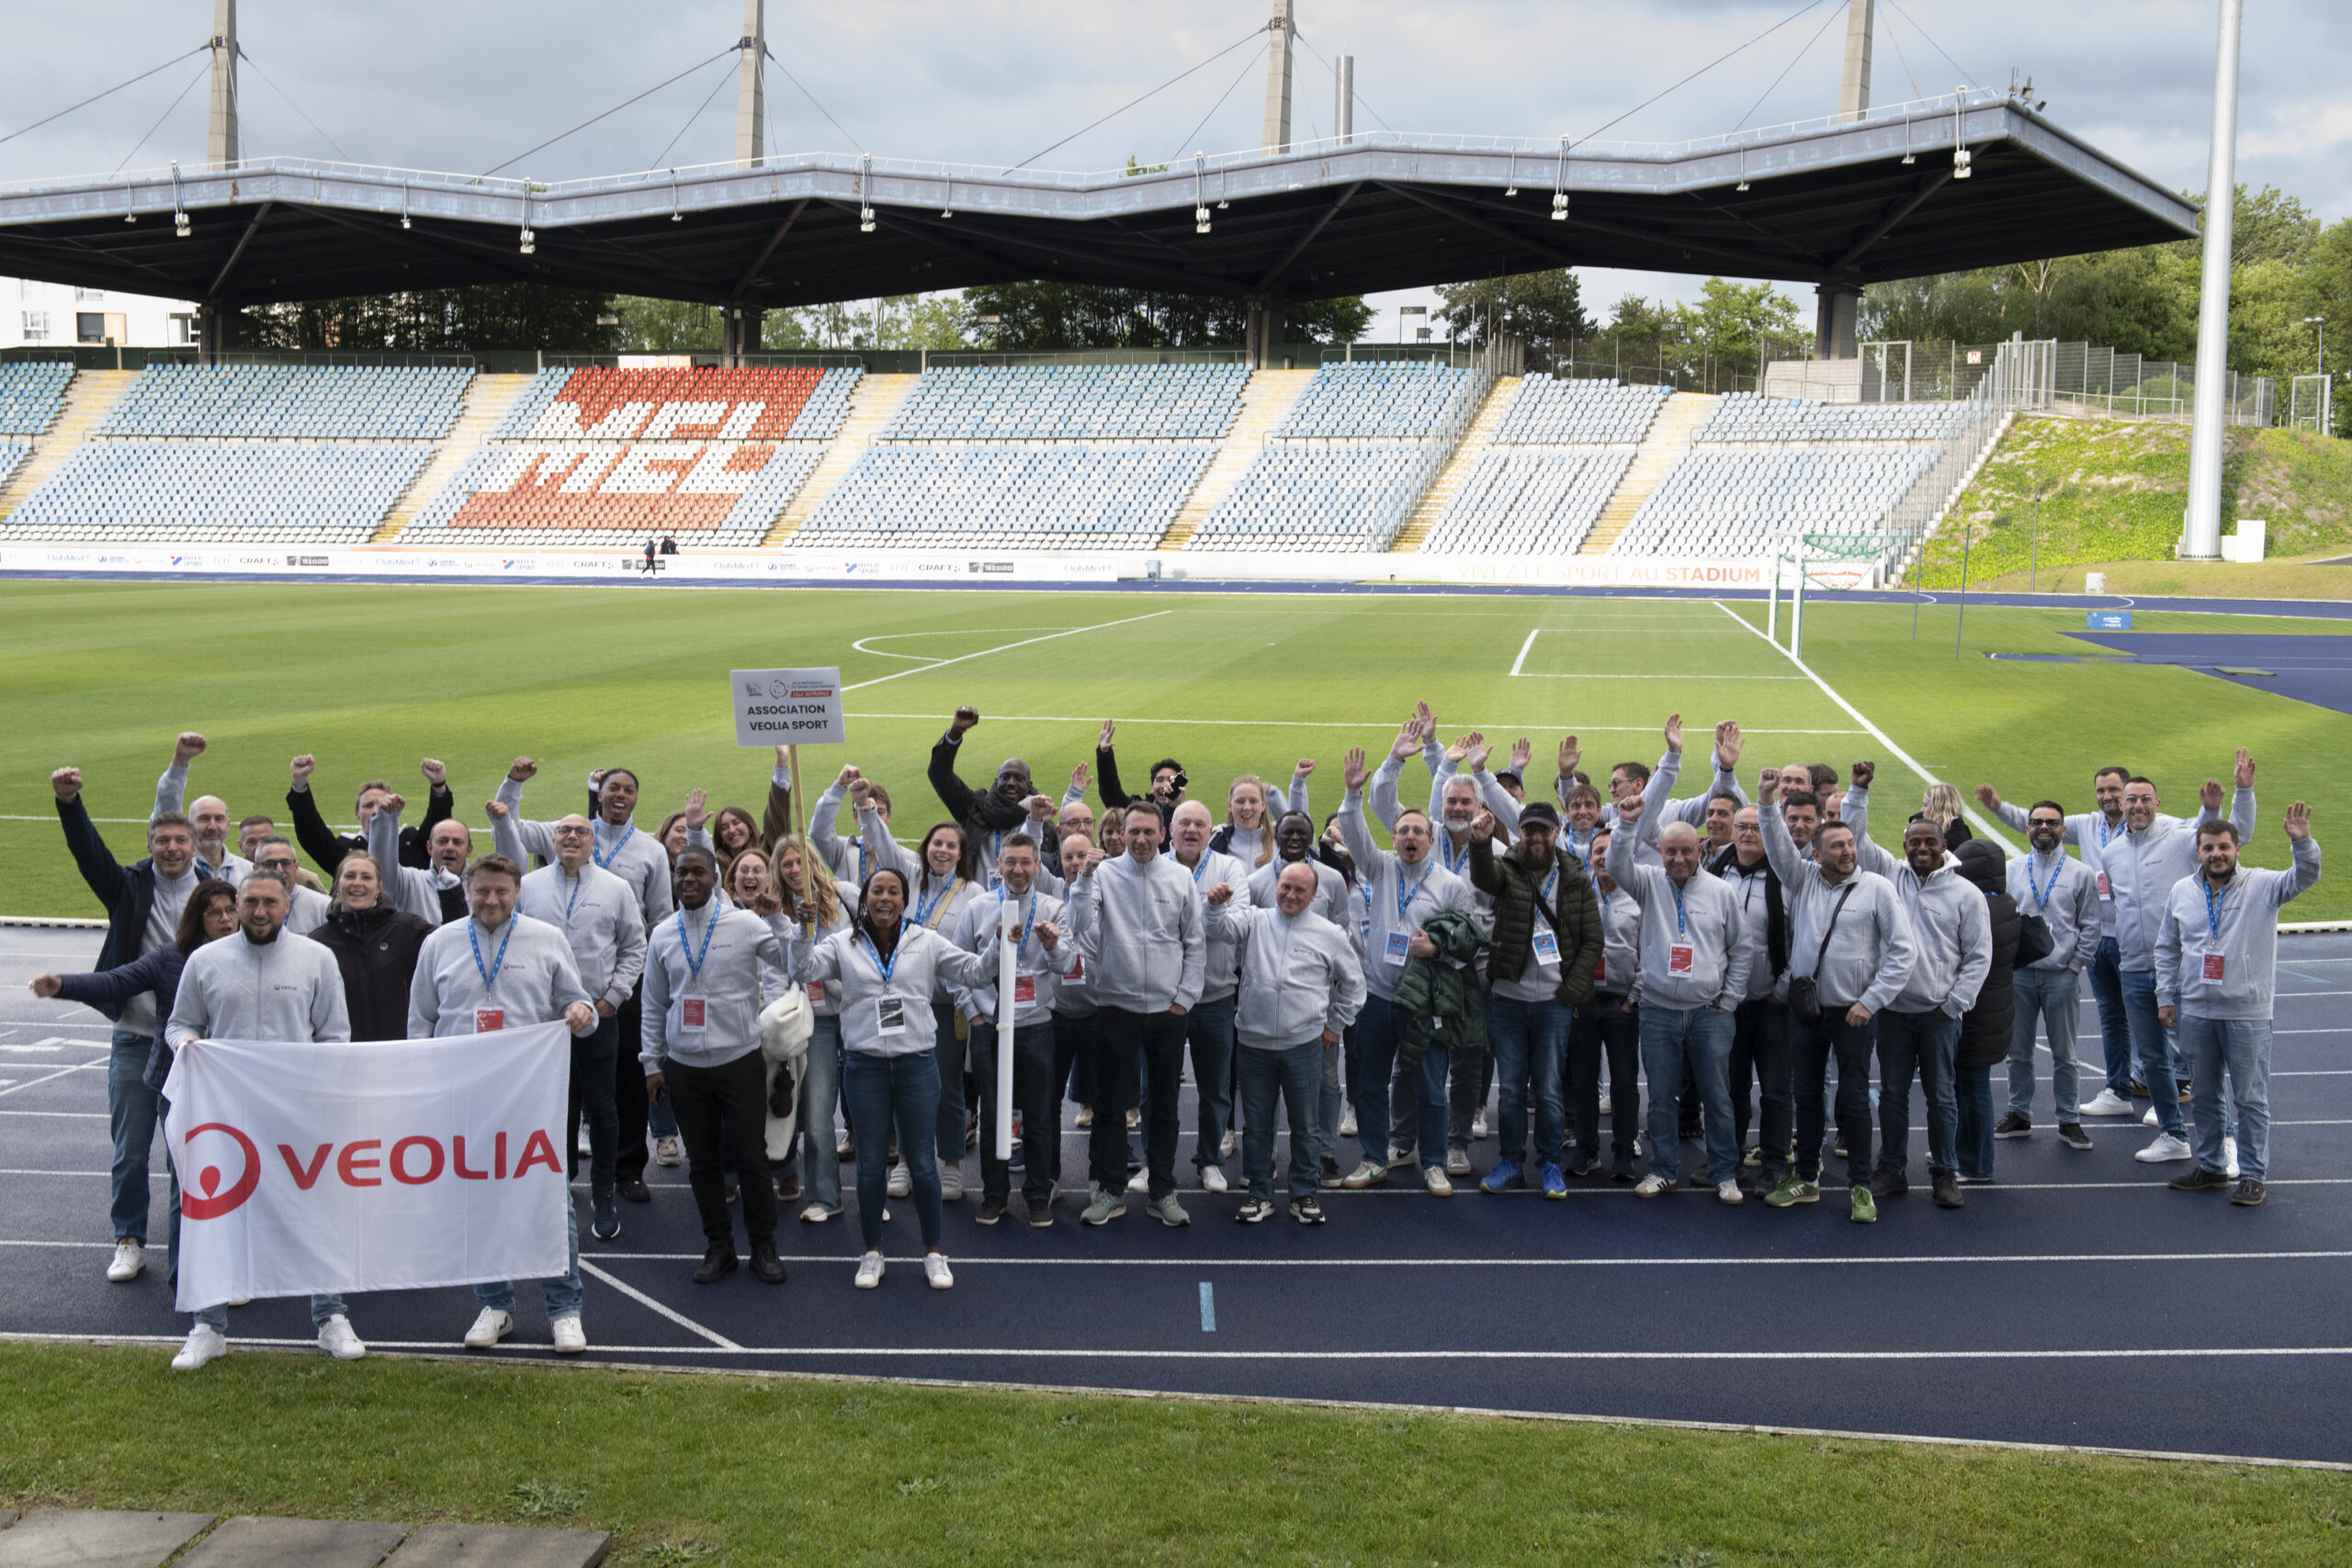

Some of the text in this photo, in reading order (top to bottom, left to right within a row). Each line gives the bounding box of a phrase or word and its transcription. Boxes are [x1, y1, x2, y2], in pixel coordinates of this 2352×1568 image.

[1457, 565, 1516, 579] VIVEZ
[1555, 566, 1621, 580] SPORT
[1630, 566, 1658, 581] AU
[1667, 567, 1760, 581] STADIUM
[748, 705, 826, 716] ASSOCIATION
[749, 720, 829, 731] VEOLIA SPORT
[277, 1129, 563, 1190] VEOLIA
